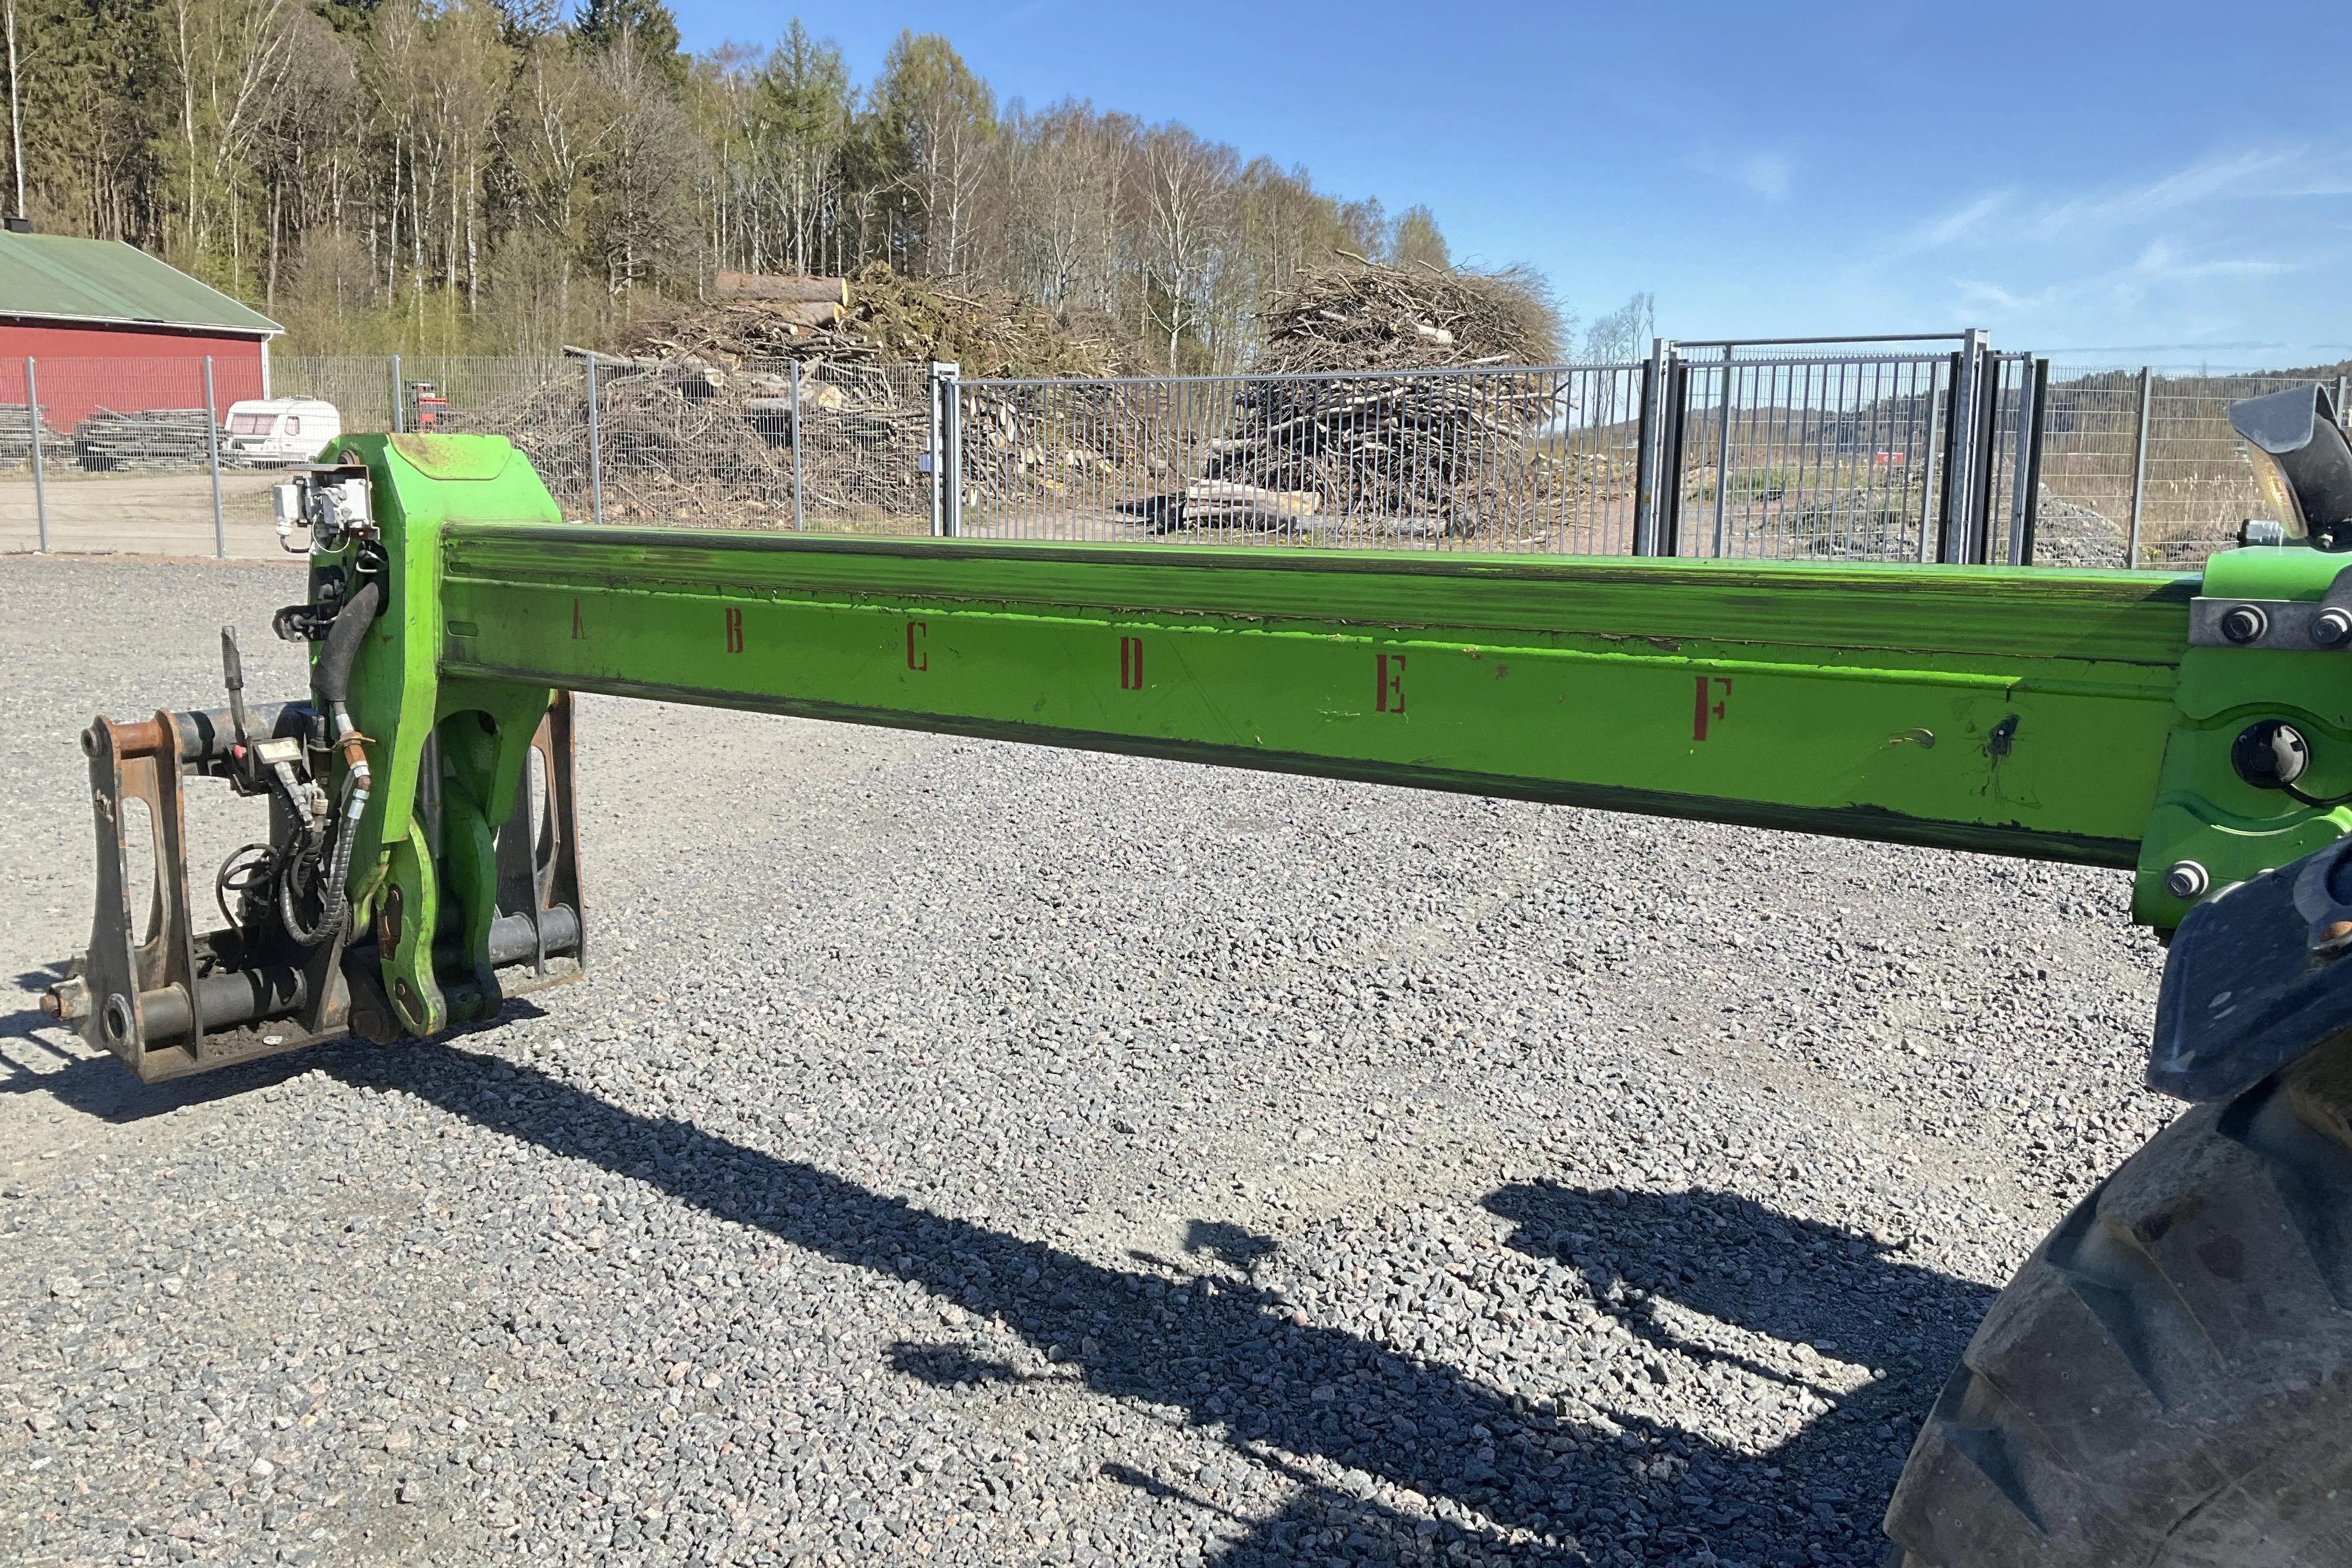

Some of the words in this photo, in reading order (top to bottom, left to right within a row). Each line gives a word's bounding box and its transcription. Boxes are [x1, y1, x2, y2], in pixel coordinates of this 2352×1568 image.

[726, 608, 743, 653] B
[907, 622, 927, 671] C
[1121, 637, 1143, 690] D
[1377, 653, 1406, 713] E
[1693, 677, 1732, 740] F
